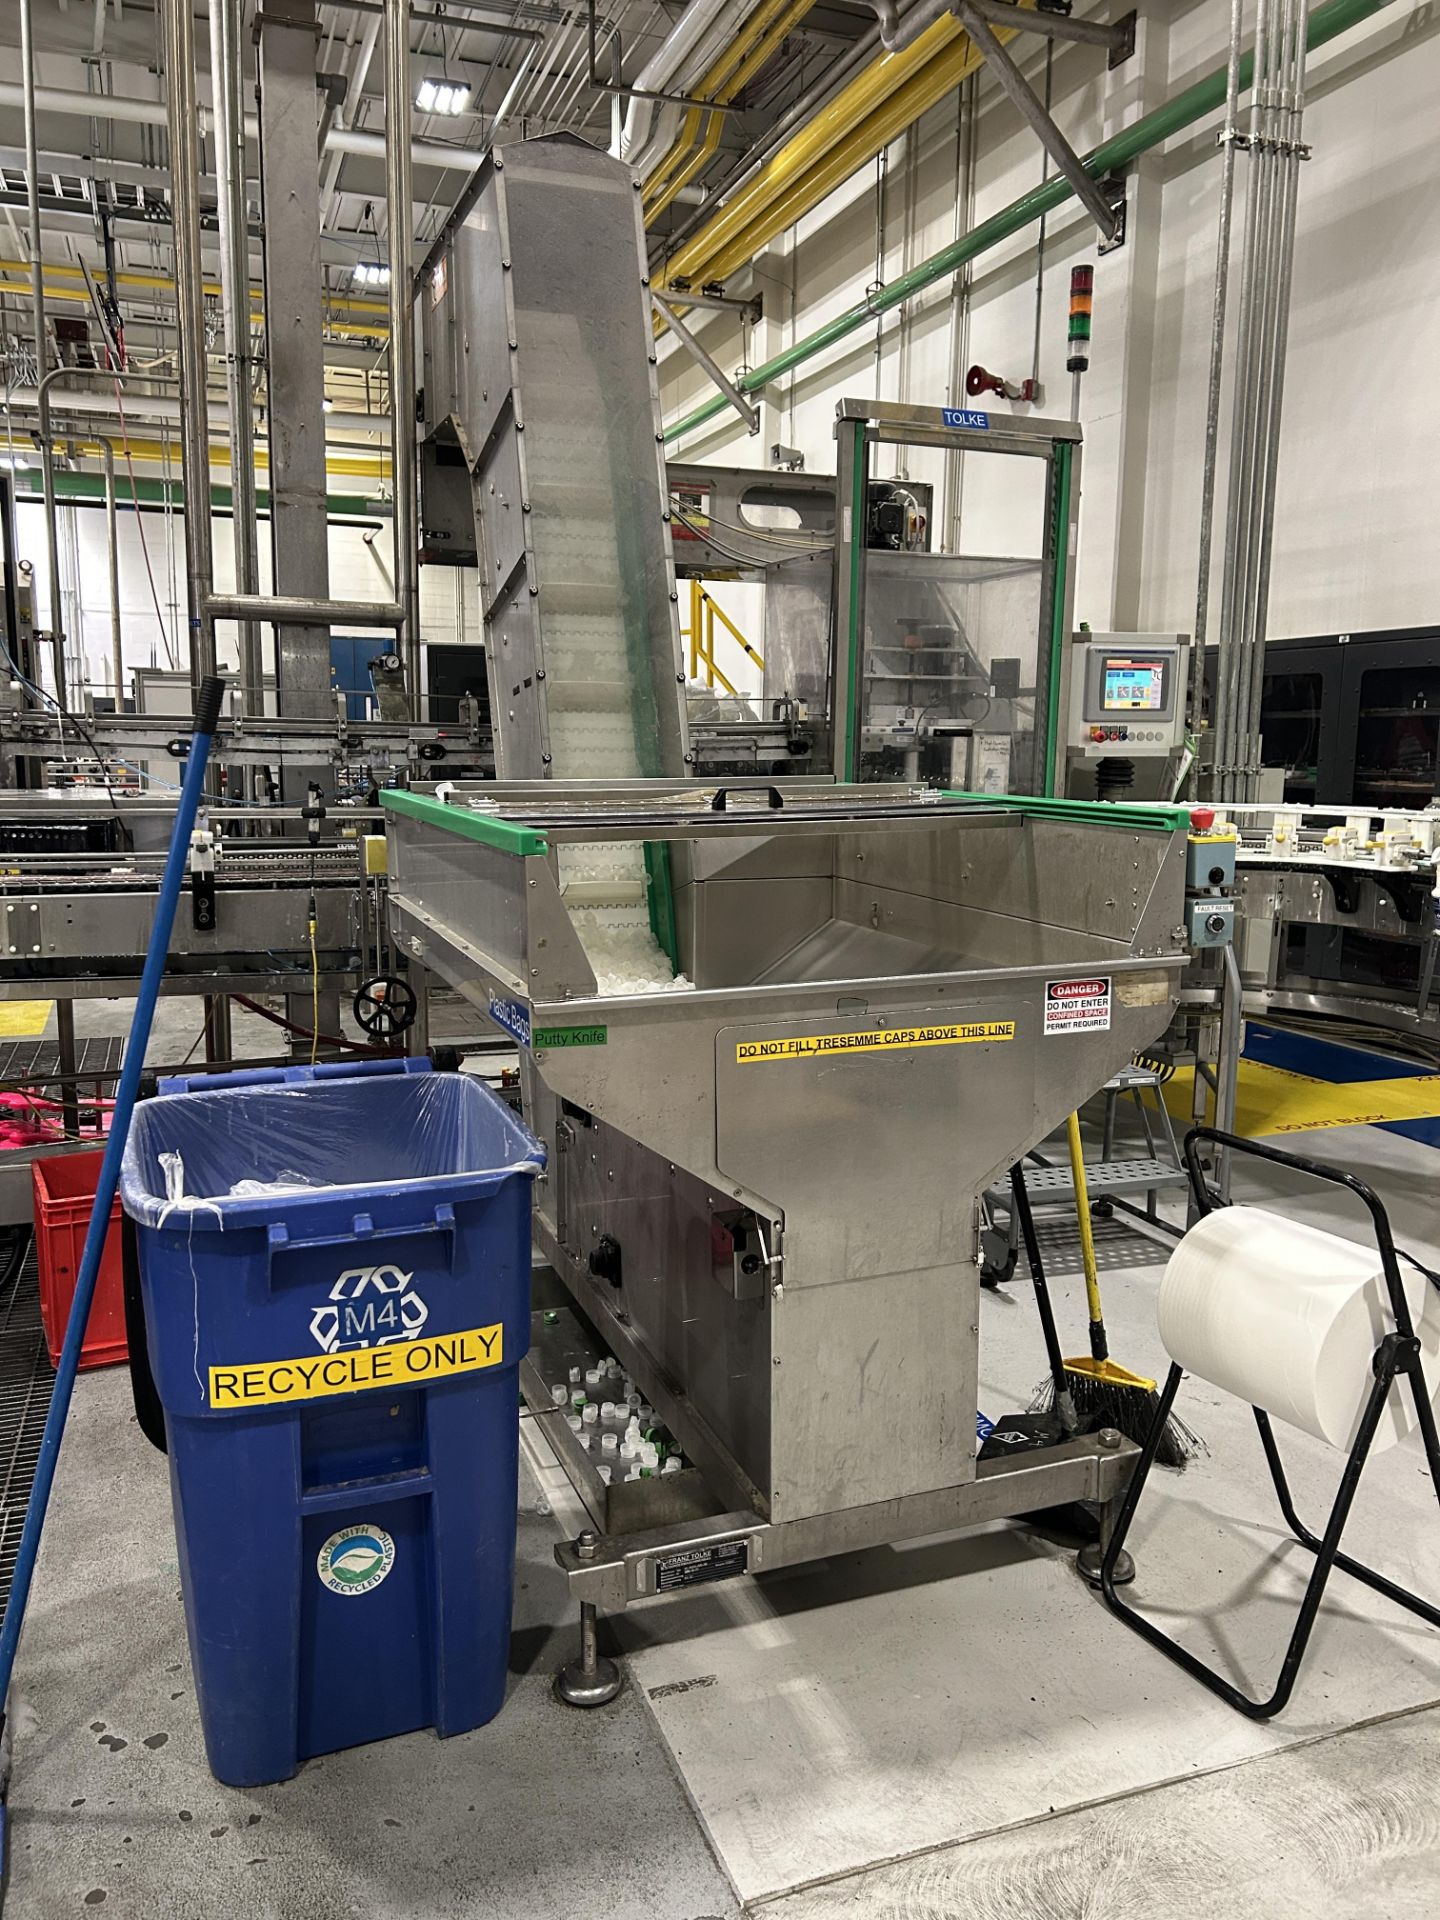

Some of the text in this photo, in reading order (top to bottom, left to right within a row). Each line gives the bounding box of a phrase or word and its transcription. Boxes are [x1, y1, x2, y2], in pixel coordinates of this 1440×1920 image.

[944, 411, 986, 426] TOLKE
[1056, 984, 1099, 995] DANGER
[1047, 998, 1109, 1011] DO NOT ENTER
[489, 988, 530, 1043] Plastic Bags
[1048, 1008, 1107, 1020] CONFINED SPACE
[1046, 1019, 1108, 1030] PERMIT REQUIRED
[534, 1030, 605, 1047] Putty Knife
[739, 1024, 1013, 1057] DO NOT FILL TRESEMME CAPS ABOVE THIS LINE
[1275, 1114, 1392, 1132] DO NOT BLOCK
[345, 1299, 399, 1336] M4
[214, 1330, 500, 1400] RECYCLE ONLY
[320, 1526, 369, 1573] MADE WITH
[328, 1532, 393, 1593] RECYCLED PLASTIC
